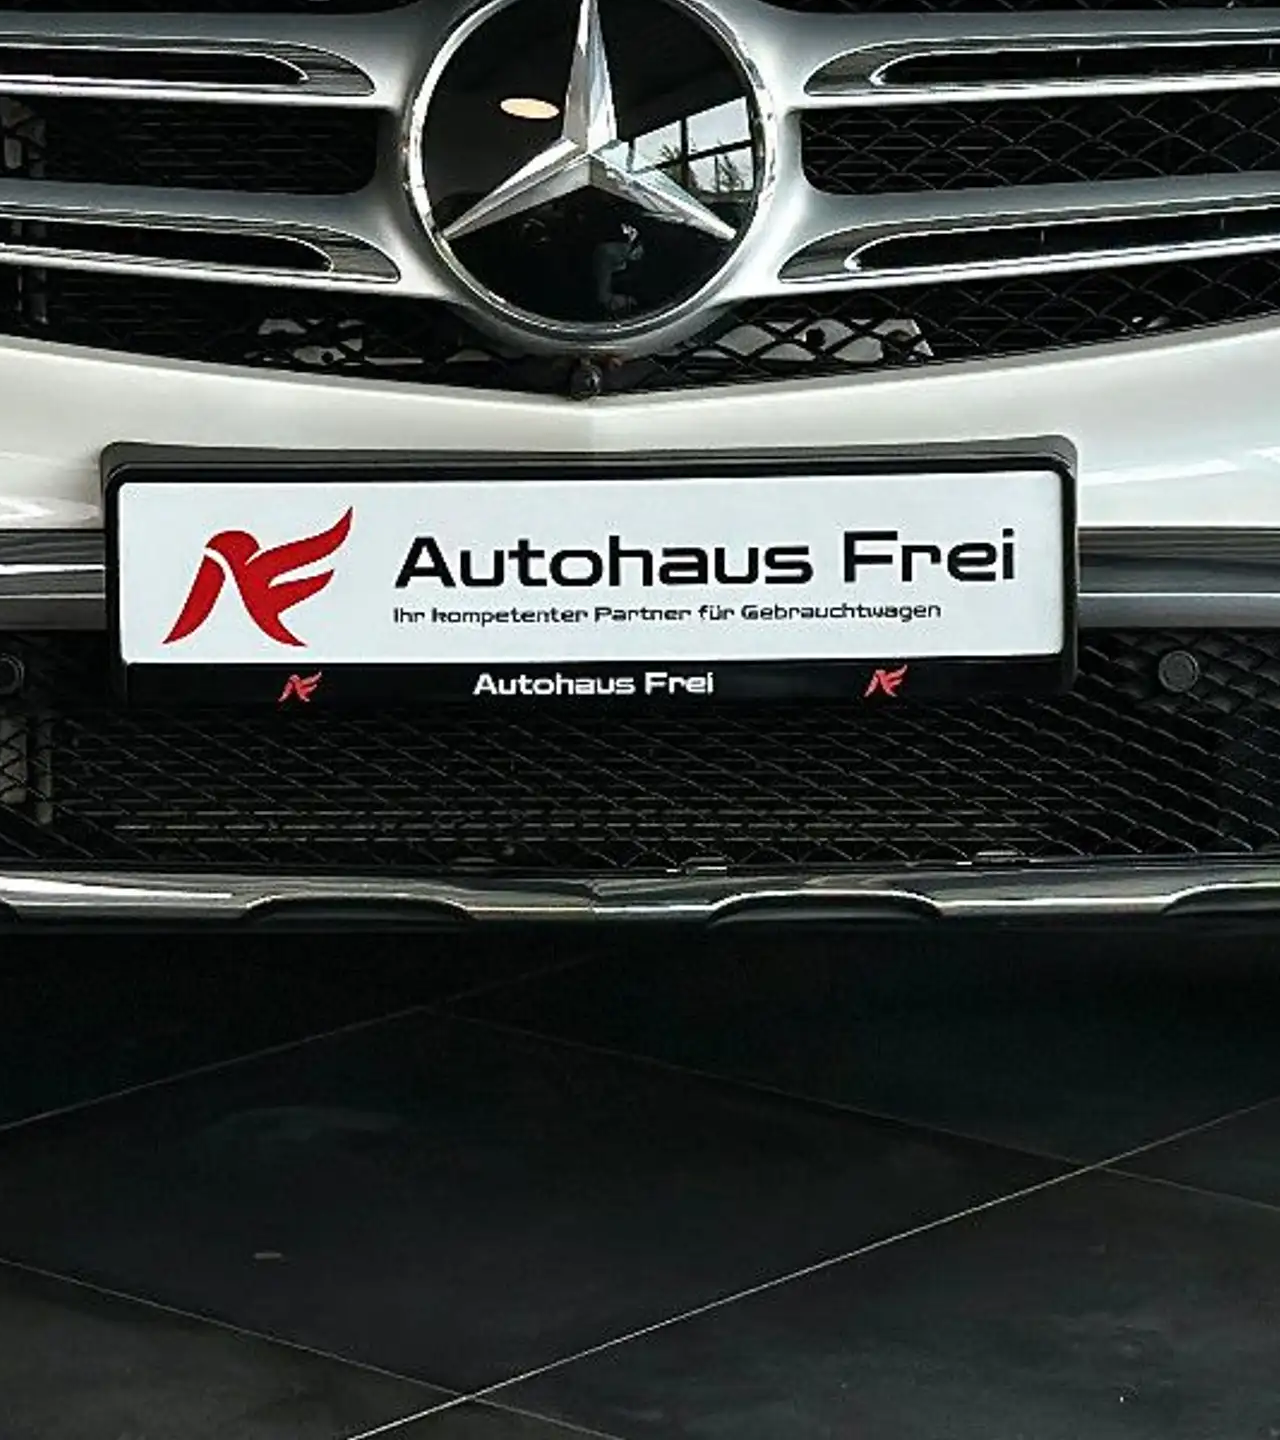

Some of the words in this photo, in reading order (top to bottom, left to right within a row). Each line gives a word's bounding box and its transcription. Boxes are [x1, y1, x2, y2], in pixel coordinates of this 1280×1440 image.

[395, 535, 814, 589] Autohaus
[843, 527, 1015, 583] Frei
[393, 607, 426, 623] Ihr
[431, 607, 589, 628] kompetenter
[594, 606, 692, 623] Partner
[697, 604, 735, 621] für
[740, 602, 942, 623] Gebrauchtwagen
[472, 672, 637, 696] Autohaus
[644, 671, 714, 695] Frei
